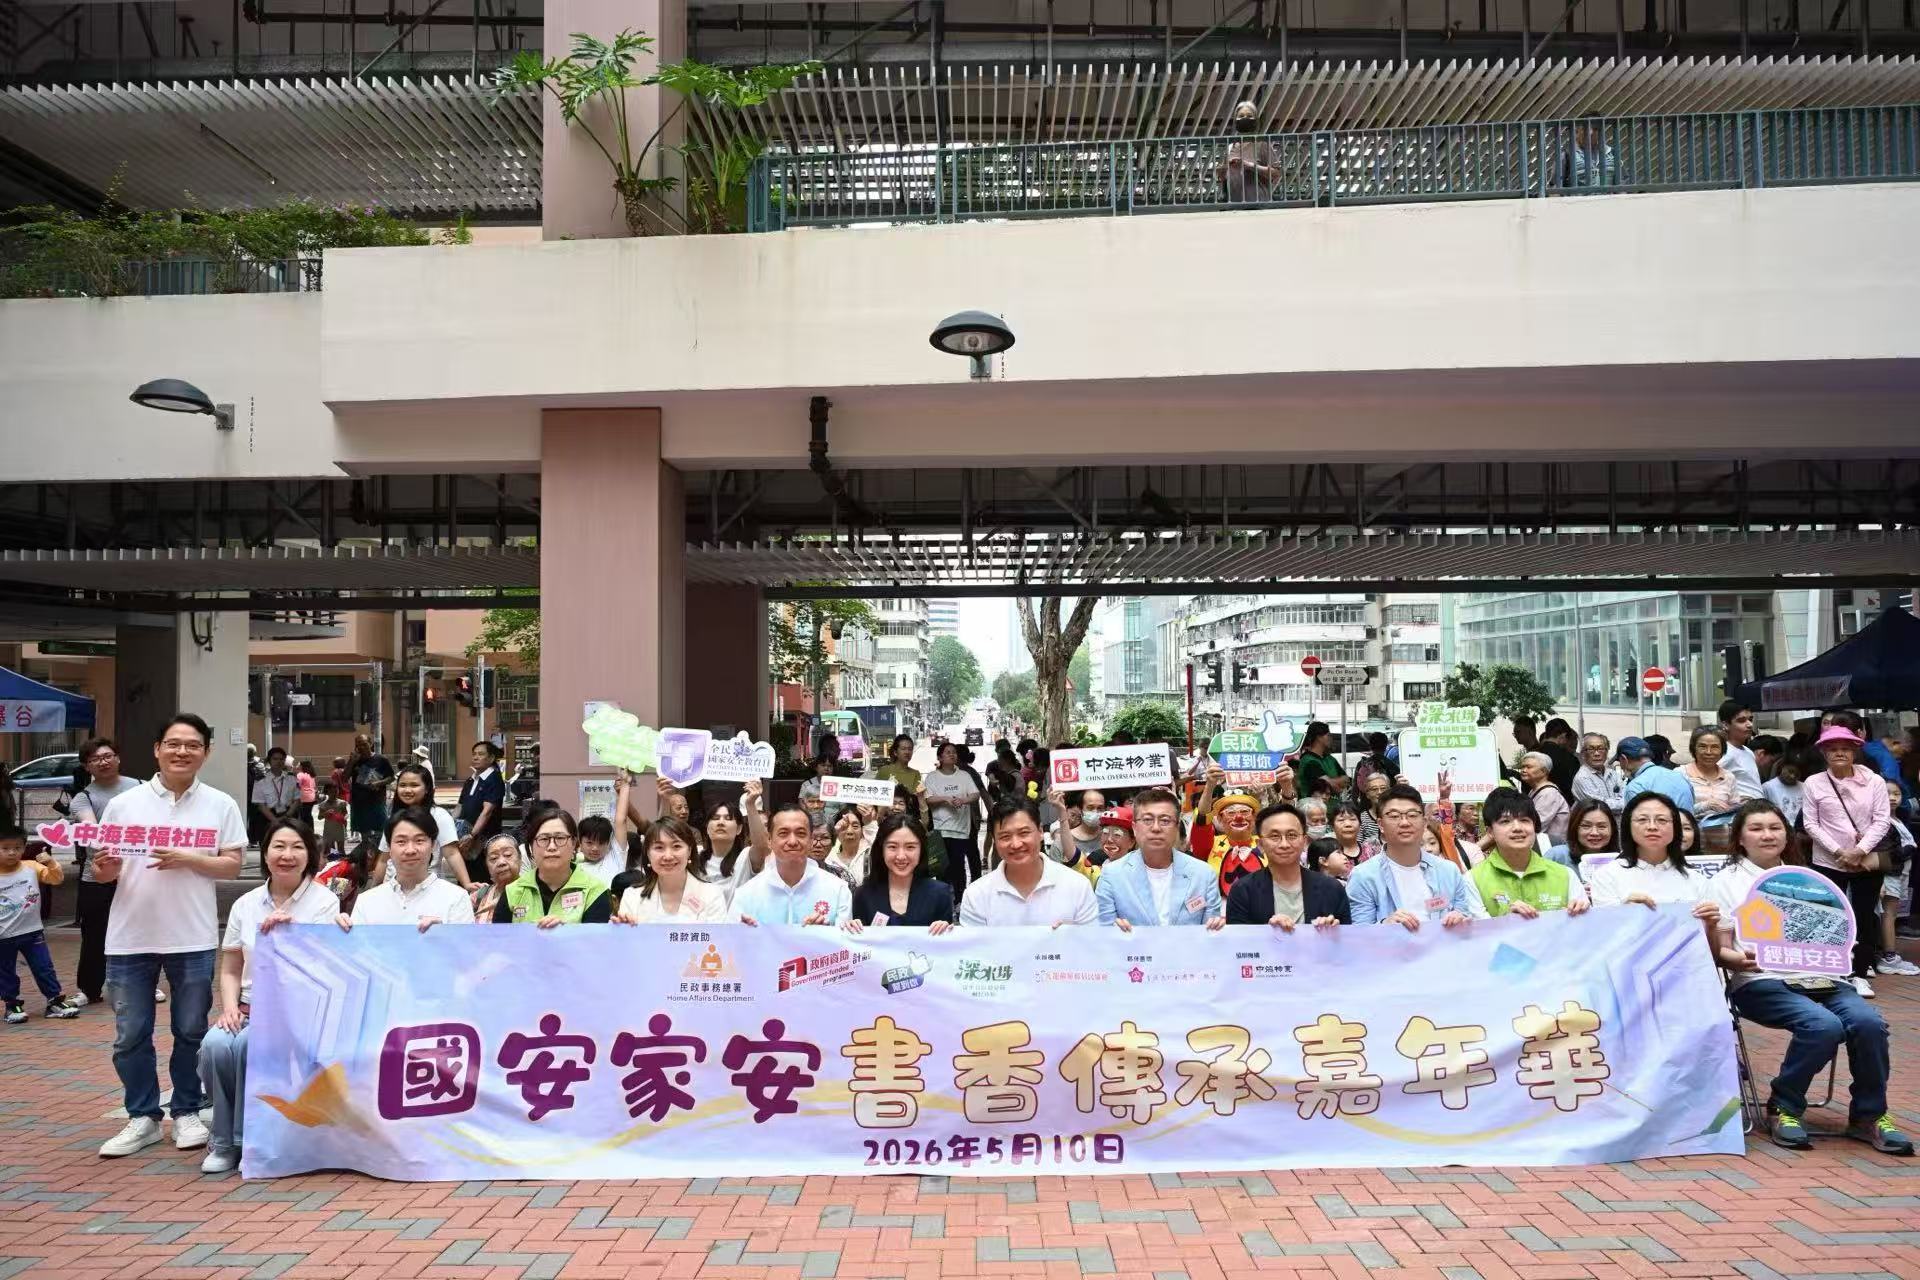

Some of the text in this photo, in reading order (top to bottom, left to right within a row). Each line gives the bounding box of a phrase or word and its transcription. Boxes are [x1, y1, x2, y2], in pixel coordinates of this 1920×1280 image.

[712, 743, 731, 755] 全民
[1221, 733, 1258, 752] 民政
[708, 755, 770, 767] 國家安全教育日
[1085, 753, 1165, 772] 中海物業
[1226, 753, 1271, 769] 幫到你
[842, 783, 892, 796] 中海物業
[74, 823, 218, 848] 中海幸福社區
[669, 932, 710, 942] 撥款資助
[809, 949, 849, 971] 政府資助
[1764, 946, 1844, 968] 經濟安全
[791, 964, 849, 988] Government-funded
[822, 970, 855, 985] programme
[886, 968, 908, 982] 民政
[954, 960, 1013, 981] 深水埗
[680, 982, 742, 993] 民政事務總署
[667, 994, 754, 1002] Home Affairs Department
[378, 1001, 1610, 1131] 國安家安書香傳承嘉年華
[863, 1133, 1124, 1168] 2026年5月10日
